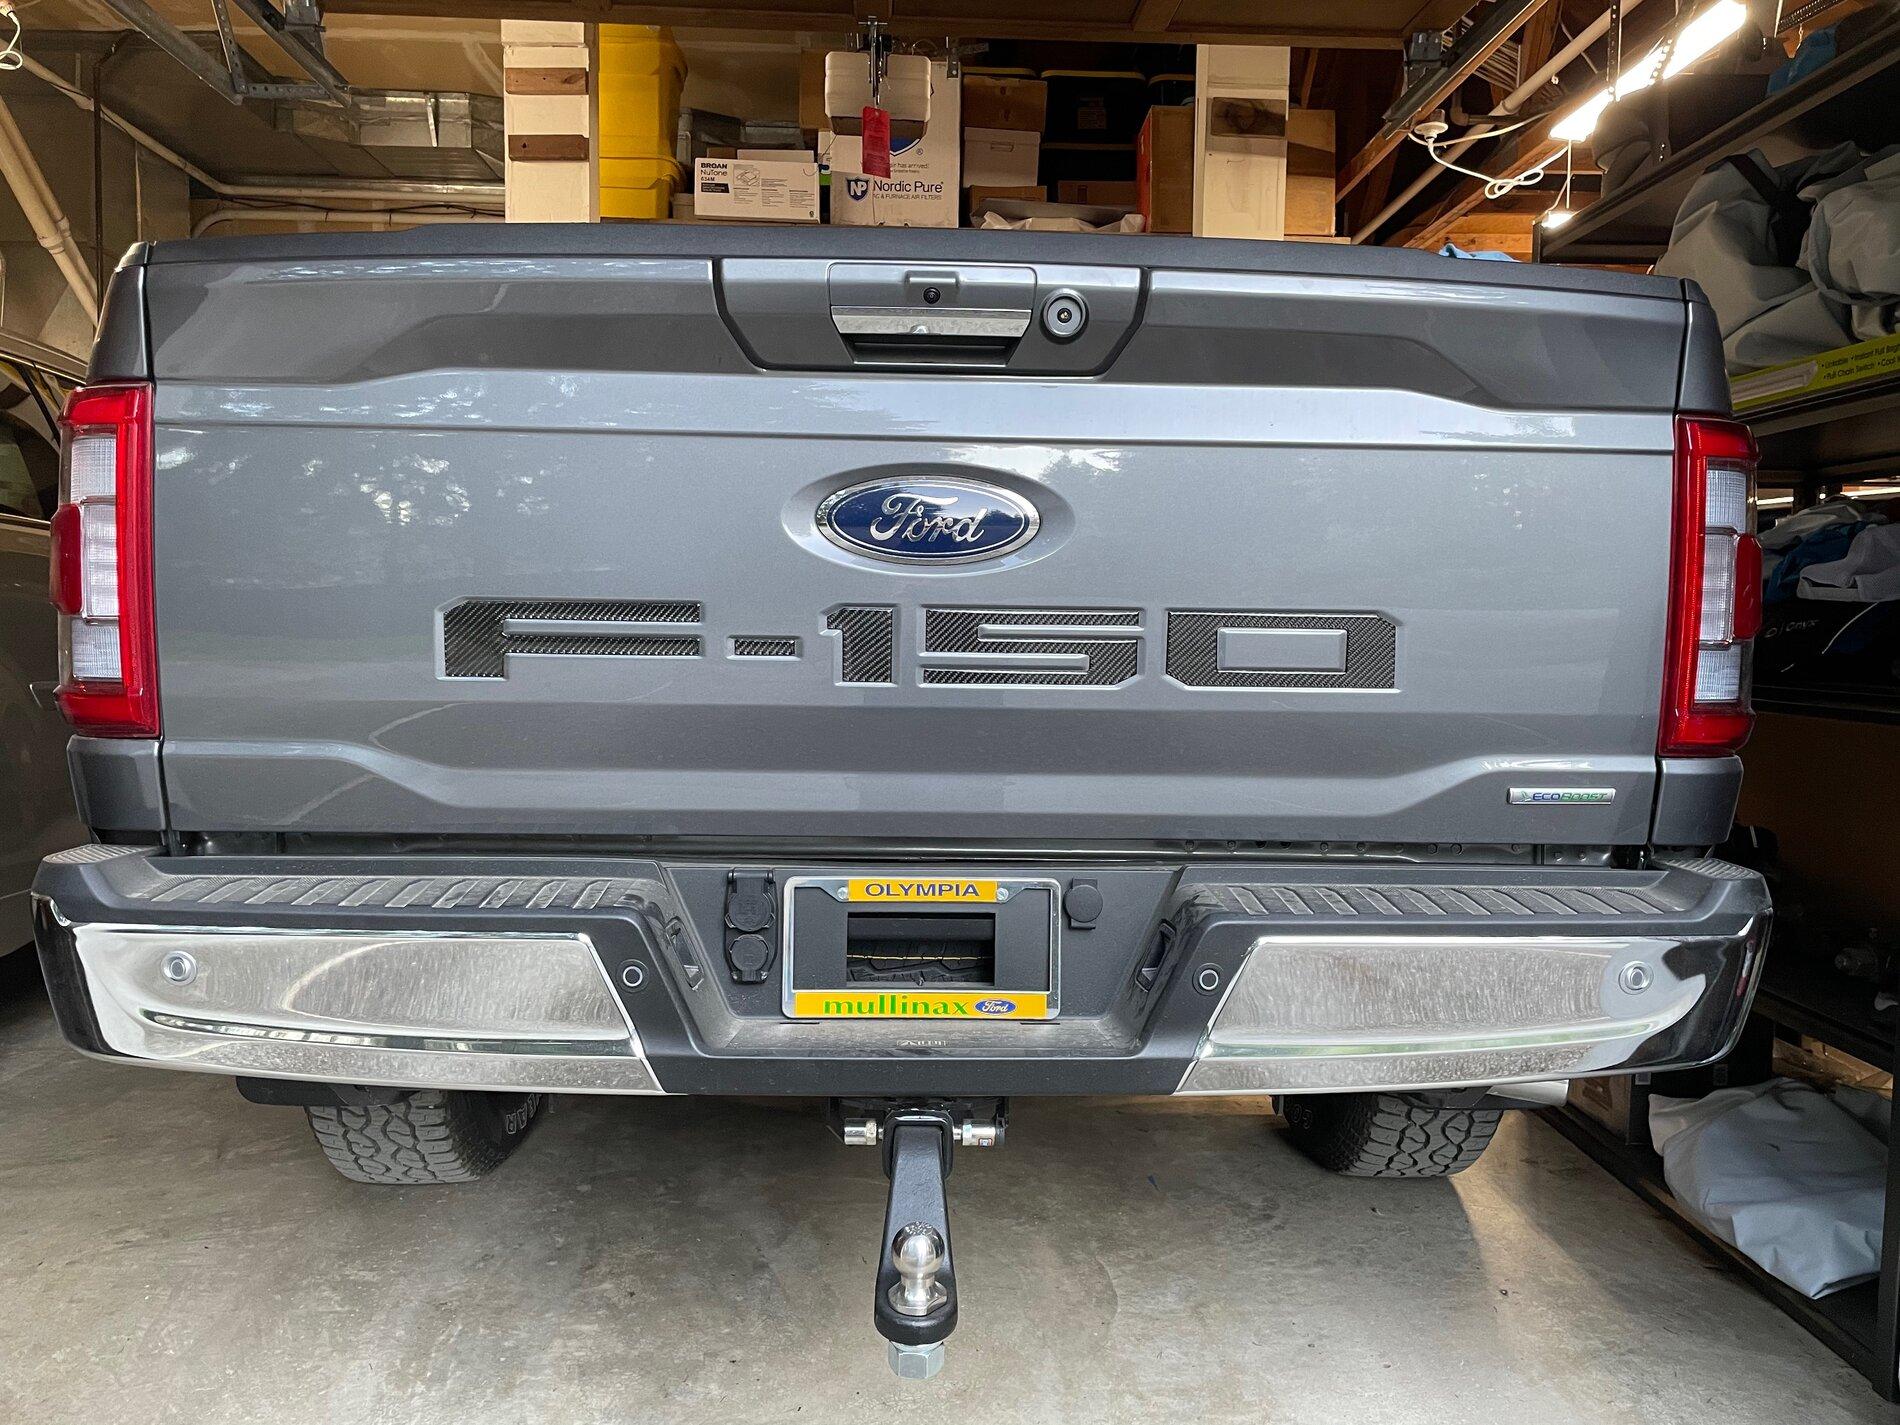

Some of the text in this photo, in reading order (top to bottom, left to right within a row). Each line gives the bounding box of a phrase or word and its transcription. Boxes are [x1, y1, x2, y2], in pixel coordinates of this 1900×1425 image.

[850, 181, 869, 196] NP
[873, 179, 943, 193] Nordic Pure
[869, 493, 988, 542] Ford
[434, 595, 1403, 695] F-150
[865, 882, 980, 897] OLYMPIA
[823, 994, 1009, 1016] mullinax Ford
